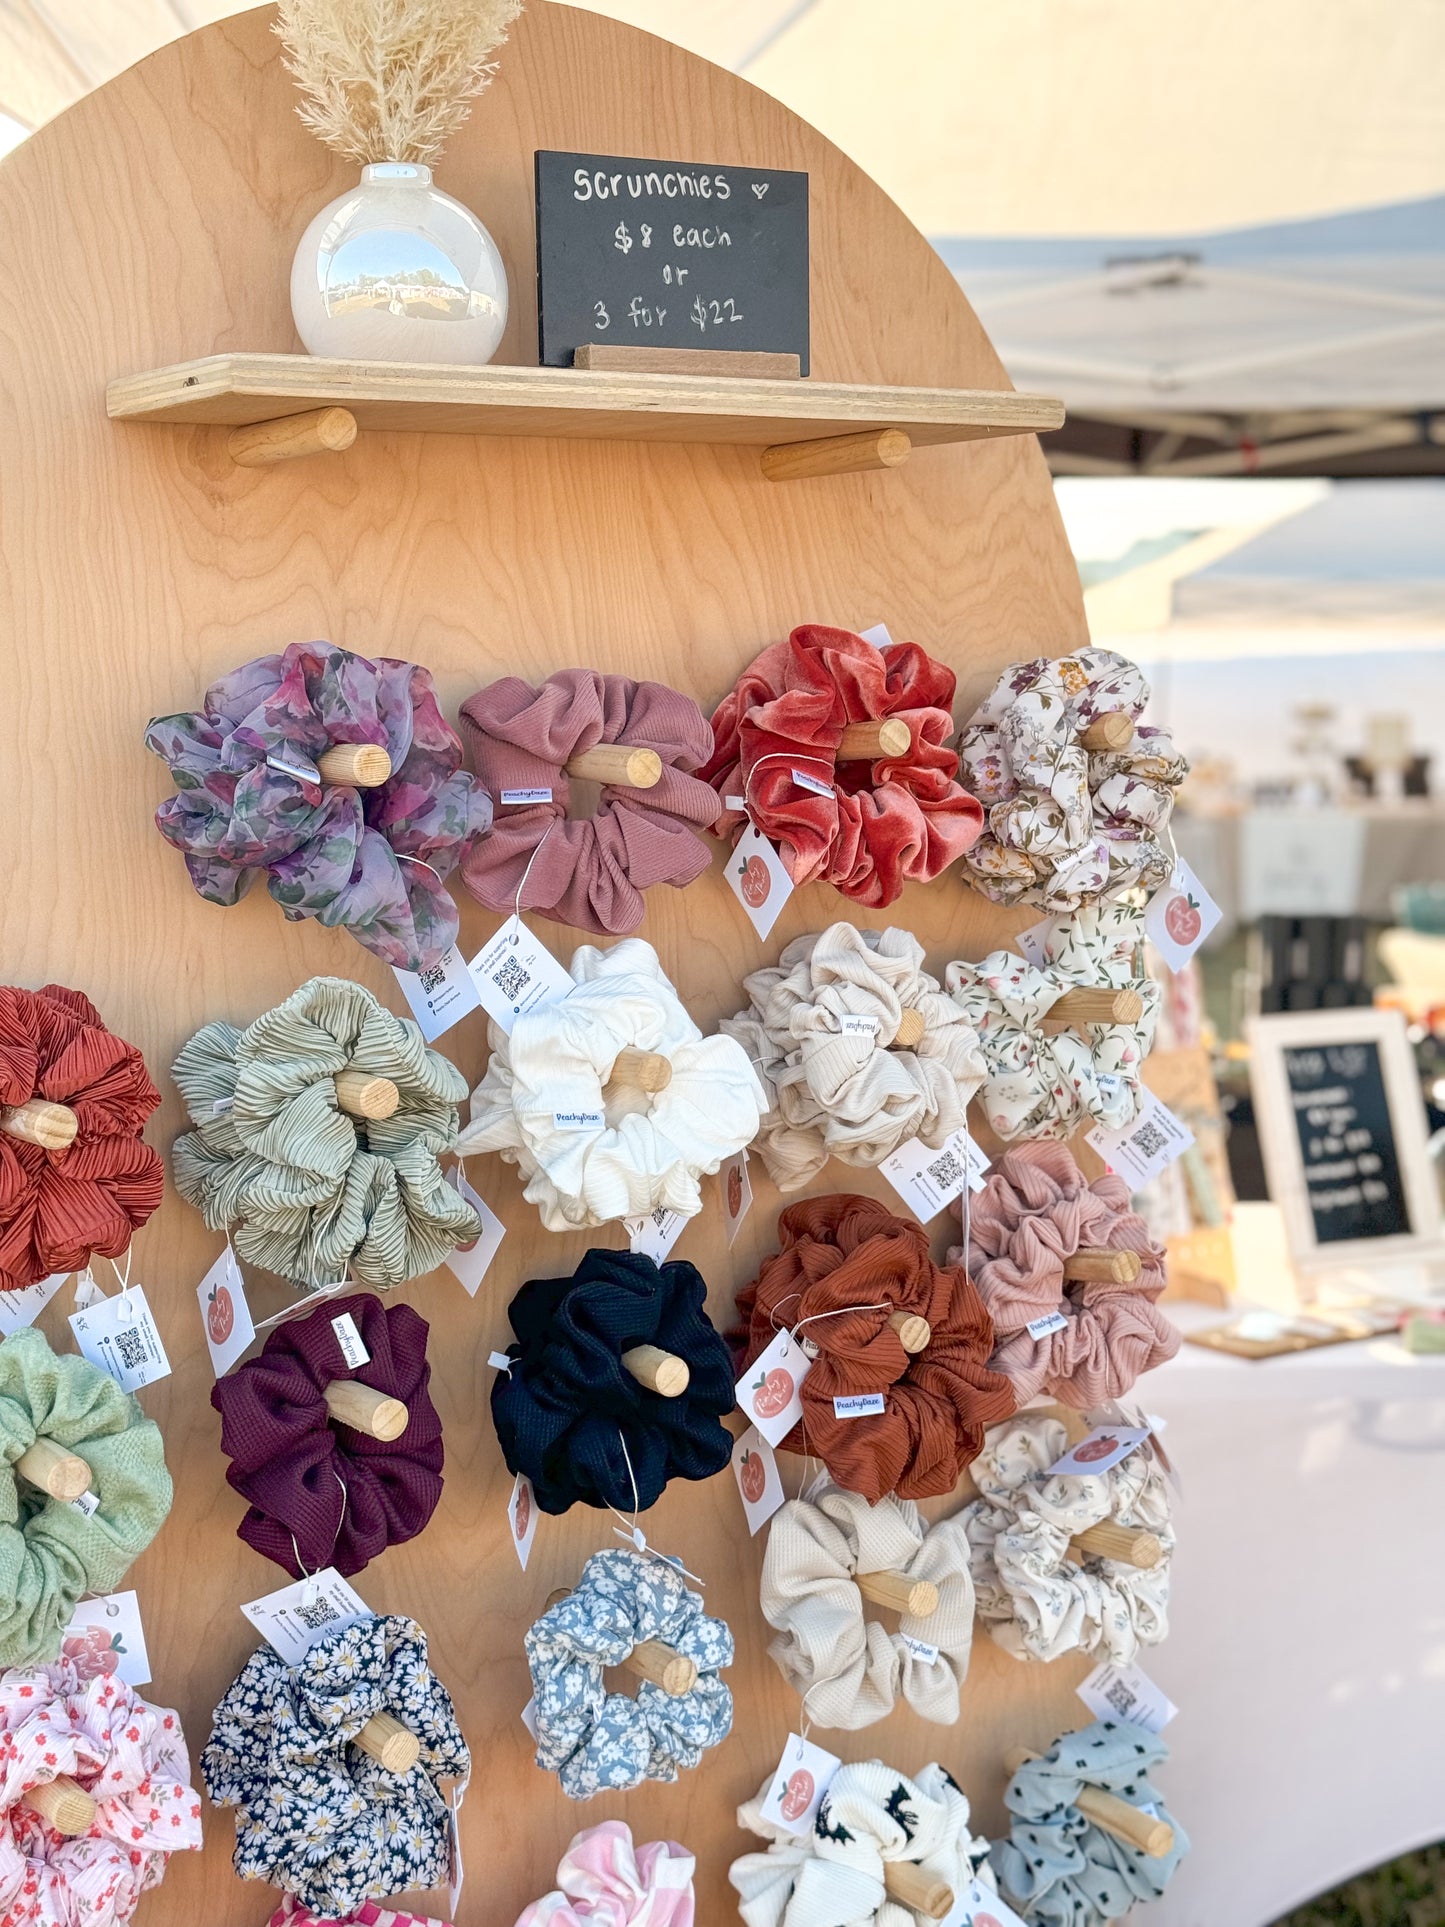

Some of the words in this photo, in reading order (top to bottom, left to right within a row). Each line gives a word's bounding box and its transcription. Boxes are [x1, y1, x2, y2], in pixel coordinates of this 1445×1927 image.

[573, 168, 732, 201] Scrunchies
[614, 220, 653, 255] $8
[672, 223, 732, 249] each
[662, 264, 689, 286] or
[593, 300, 611, 330] 3
[627, 295, 667, 328] for
[690, 294, 744, 332] $22
[556, 1112, 600, 1124] PeachyDaze
[336, 1320, 360, 1366] PeachyDaze
[836, 1398, 880, 1410] PeachyDaze
